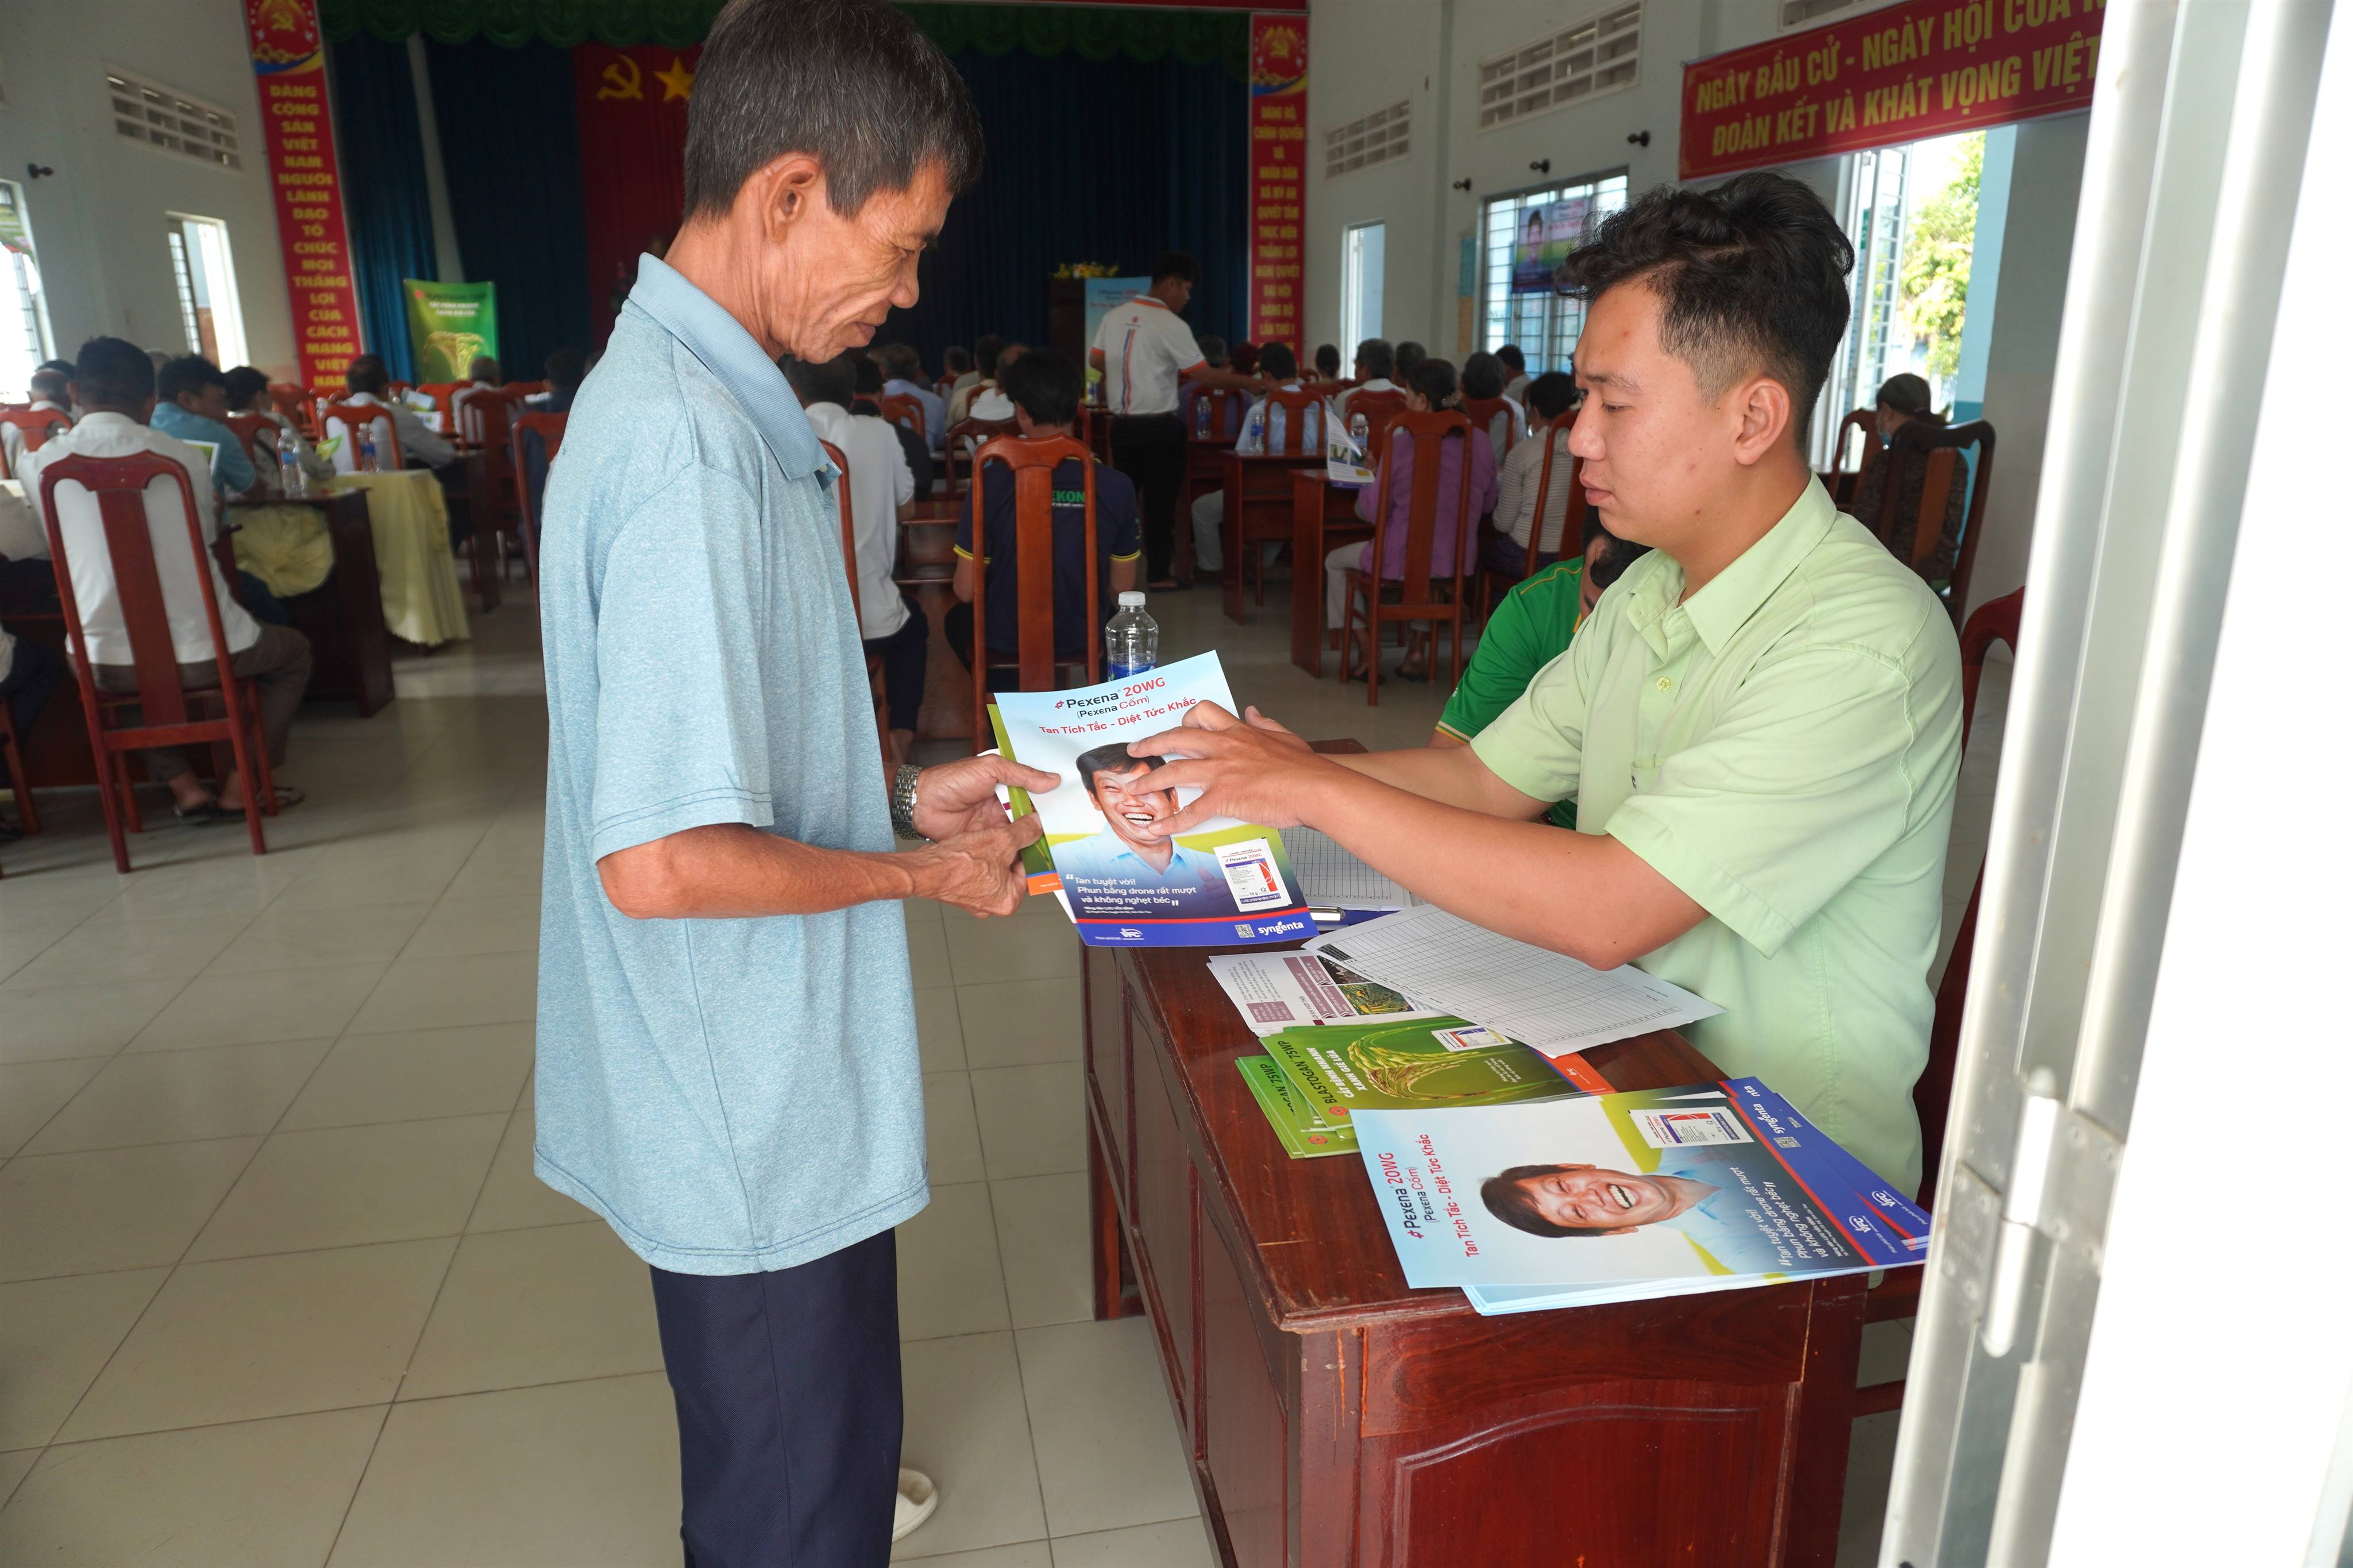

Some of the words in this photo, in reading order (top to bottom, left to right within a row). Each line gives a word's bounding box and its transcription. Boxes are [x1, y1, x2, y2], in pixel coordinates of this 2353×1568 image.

[1696, 69, 1751, 114] NGÀY
[1755, 49, 1799, 99] BẦU
[1807, 34, 1841, 86] CỬ
[1862, 16, 1935, 72] NGÀY
[1712, 113, 1770, 156] ĐOÀN
[1776, 95, 1819, 144] KẾT
[1826, 89, 1856, 134] VÀ
[1863, 74, 1933, 127] KHÁT
[1941, 56, 2022, 114] VỌNG
[2033, 30, 2101, 94] VIỆT
[284, 156, 322, 167] NAM
[306, 325, 349, 337] CÁCH
[1066, 693, 1118, 708] Pexena
[1124, 678, 1165, 697] 20WG
[1077, 706, 1117, 719] (Pexena
[1120, 696, 1149, 709] Cốm)
[1087, 721, 1107, 731] Tắc
[1118, 714, 1141, 725] Diệt
[1143, 708, 1165, 717] Tức
[1167, 697, 1199, 711] Khắc
[1093, 878, 1117, 887] tuyệt
[1103, 886, 1127, 895] bằng
[1157, 886, 1170, 894] rất
[1257, 921, 1304, 936] syngenta
[1278, 1041, 1301, 1059] 75WP
[1306, 1048, 1331, 1069] NHANH
[1326, 1050, 1342, 1061] LÚA
[1260, 1064, 1282, 1083] 75WP
[1294, 1061, 1337, 1103] BLASTOGAN
[1325, 1070, 1345, 1086] BỆNH
[1345, 1073, 1367, 1091] XANH
[1753, 1103, 1784, 1134] syngenta
[1415, 1135, 1435, 1155] Khắc
[1379, 1153, 1403, 1184] 20WG
[1428, 1158, 1442, 1174] Tức
[1406, 1167, 1423, 1189] Cốm)
[1434, 1176, 1451, 1193] Diệt
[1730, 1167, 1751, 1184] mượt
[1743, 1187, 1760, 1195] rất
[1395, 1189, 1421, 1228] Pexena
[1418, 1191, 1440, 1223] (Pexena
[1444, 1202, 1461, 1217] Tắc
[1745, 1210, 1764, 1222] vời!
[1756, 1198, 1777, 1216] drone
[1775, 1202, 1800, 1222] nghẹt
[1453, 1219, 1471, 1238] Tích
[1758, 1225, 1781, 1244] tuyệt
[1773, 1219, 1794, 1237] bằng
[1795, 1224, 1820, 1246] không
[1465, 1241, 1479, 1257] Tan
[1789, 1239, 1812, 1258] Phun
[1813, 1249, 1829, 1257] và
